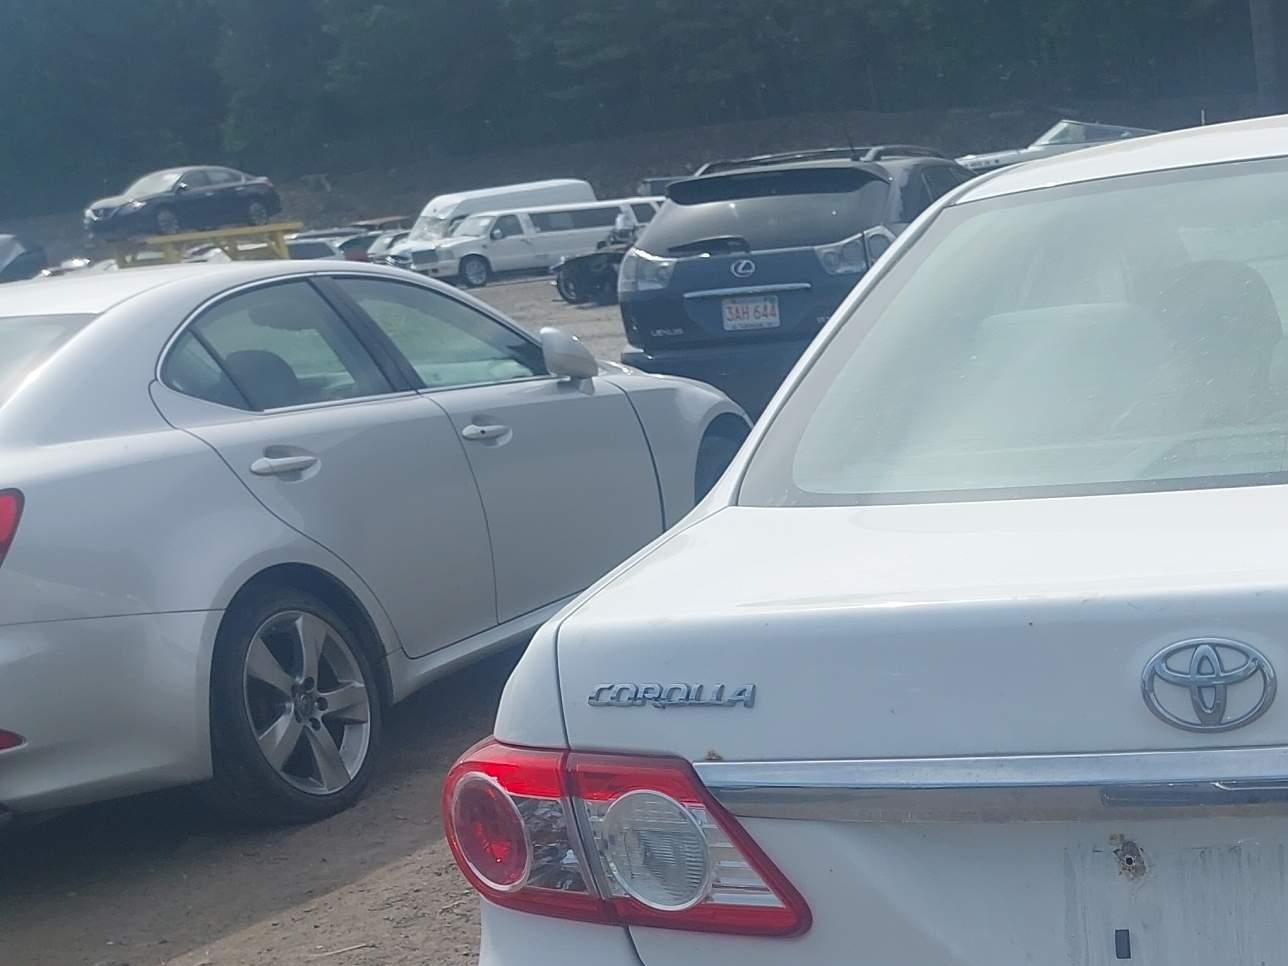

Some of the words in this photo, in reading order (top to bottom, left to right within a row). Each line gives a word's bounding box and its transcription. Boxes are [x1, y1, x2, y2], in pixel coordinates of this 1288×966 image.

[726, 304, 750, 321] 3AH
[752, 303, 777, 320] 644
[588, 683, 756, 709] COROLLA
